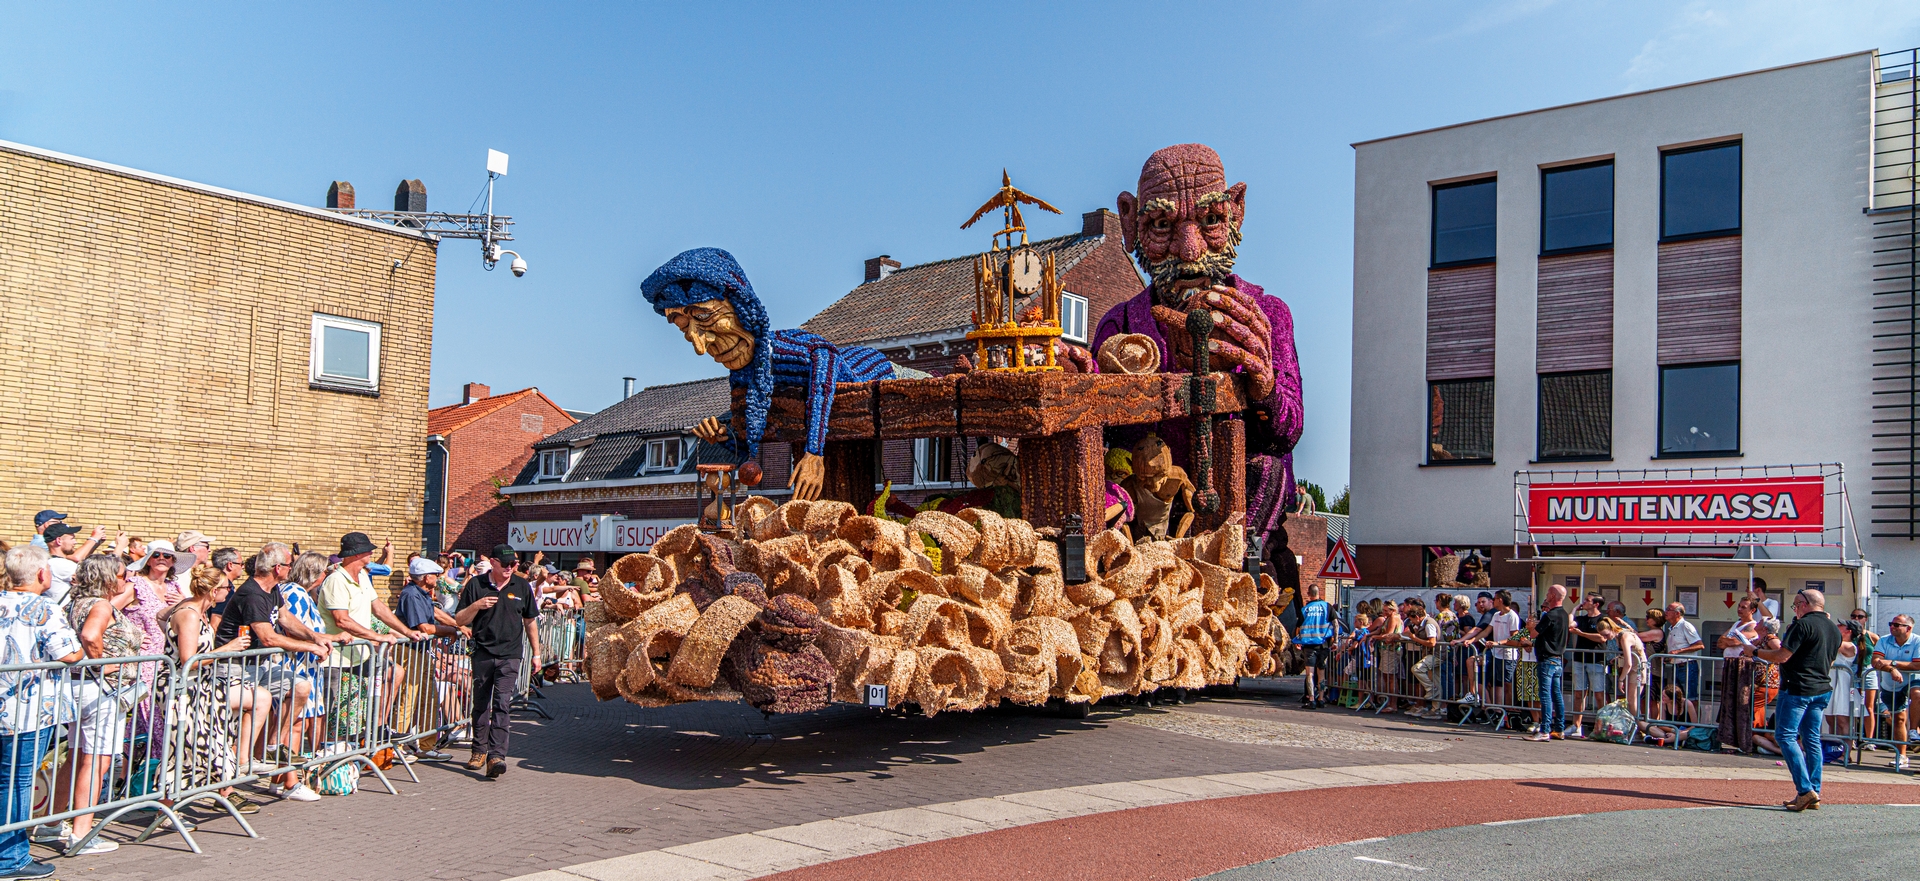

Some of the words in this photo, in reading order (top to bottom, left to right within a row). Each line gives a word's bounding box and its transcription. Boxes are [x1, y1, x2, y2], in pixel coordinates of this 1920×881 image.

[1548, 493, 1800, 521] MUNTENKASSA
[543, 527, 582, 547] LUCKY
[627, 526, 669, 547] SUSH
[871, 687, 884, 699] 01
